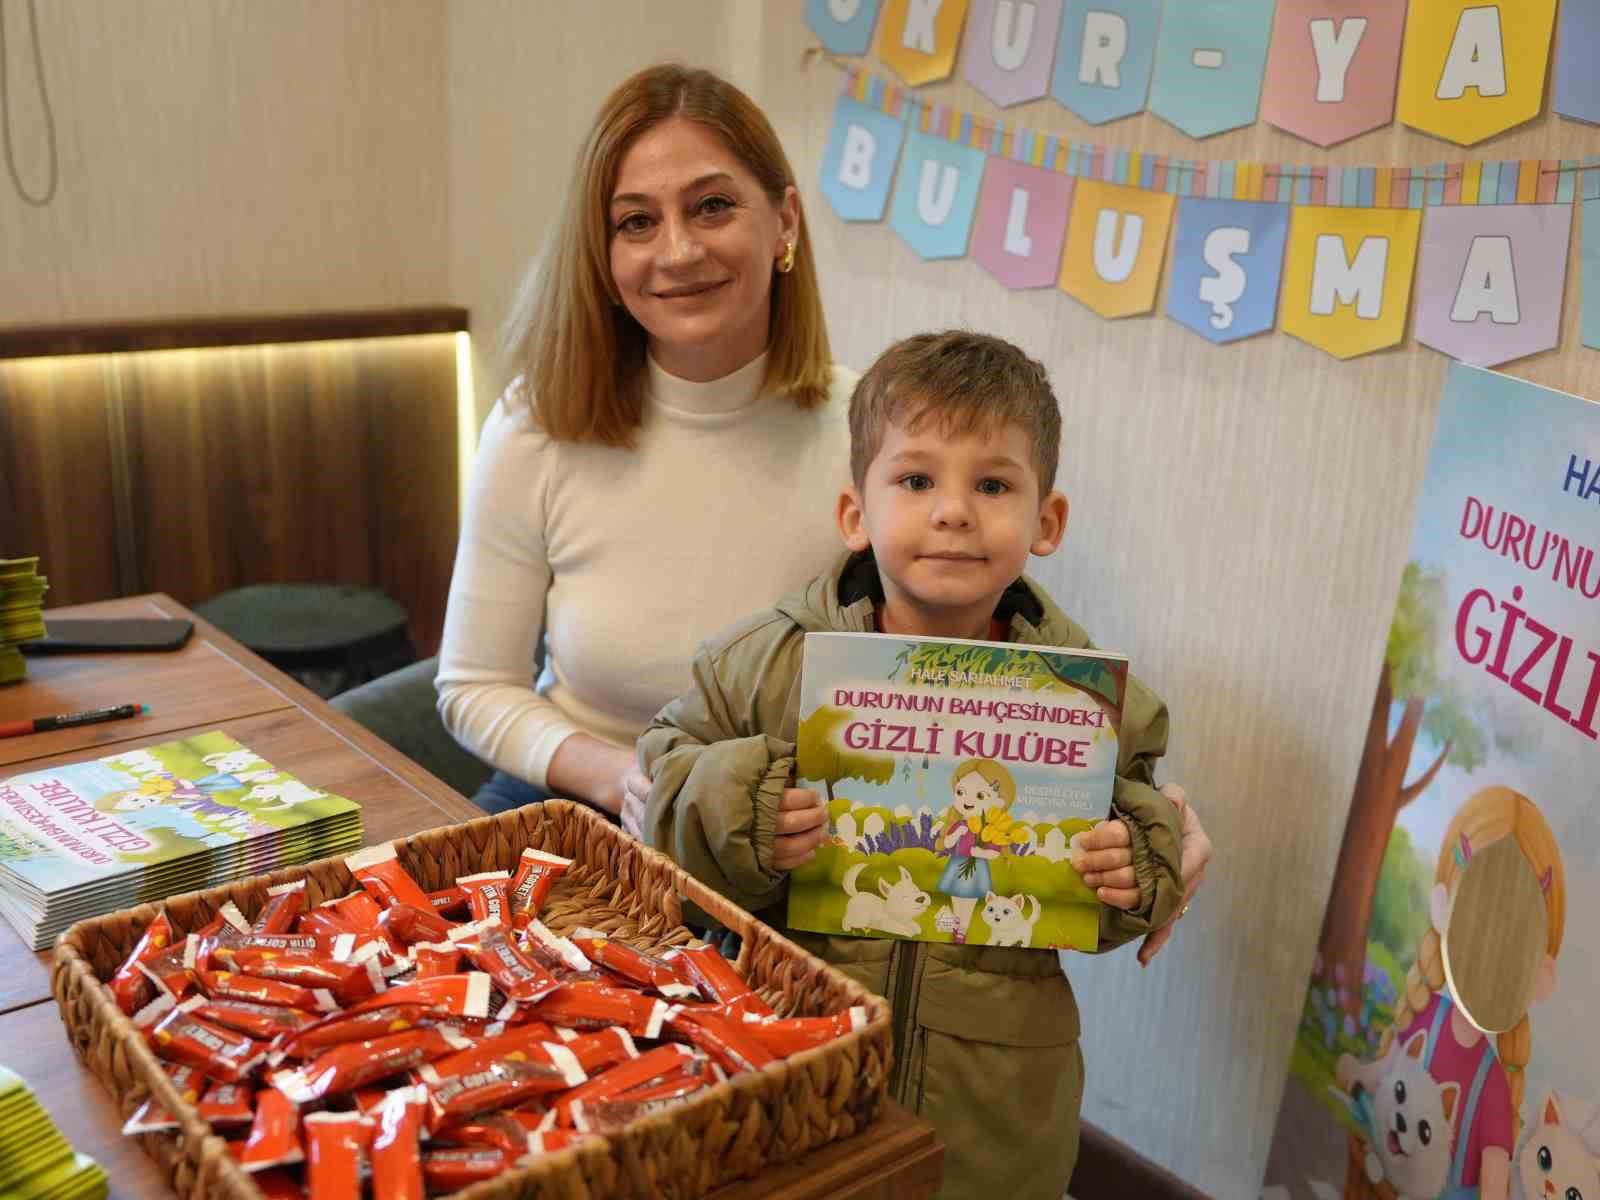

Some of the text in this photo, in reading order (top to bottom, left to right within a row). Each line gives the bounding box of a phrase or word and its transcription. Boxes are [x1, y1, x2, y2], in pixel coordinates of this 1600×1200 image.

[838, 123, 1521, 330] BULUŞMA
[834, 689, 1105, 728] DURU'NUN BAHÇESİNDEKİ
[844, 718, 1091, 768] GİZLİ KULÜBE
